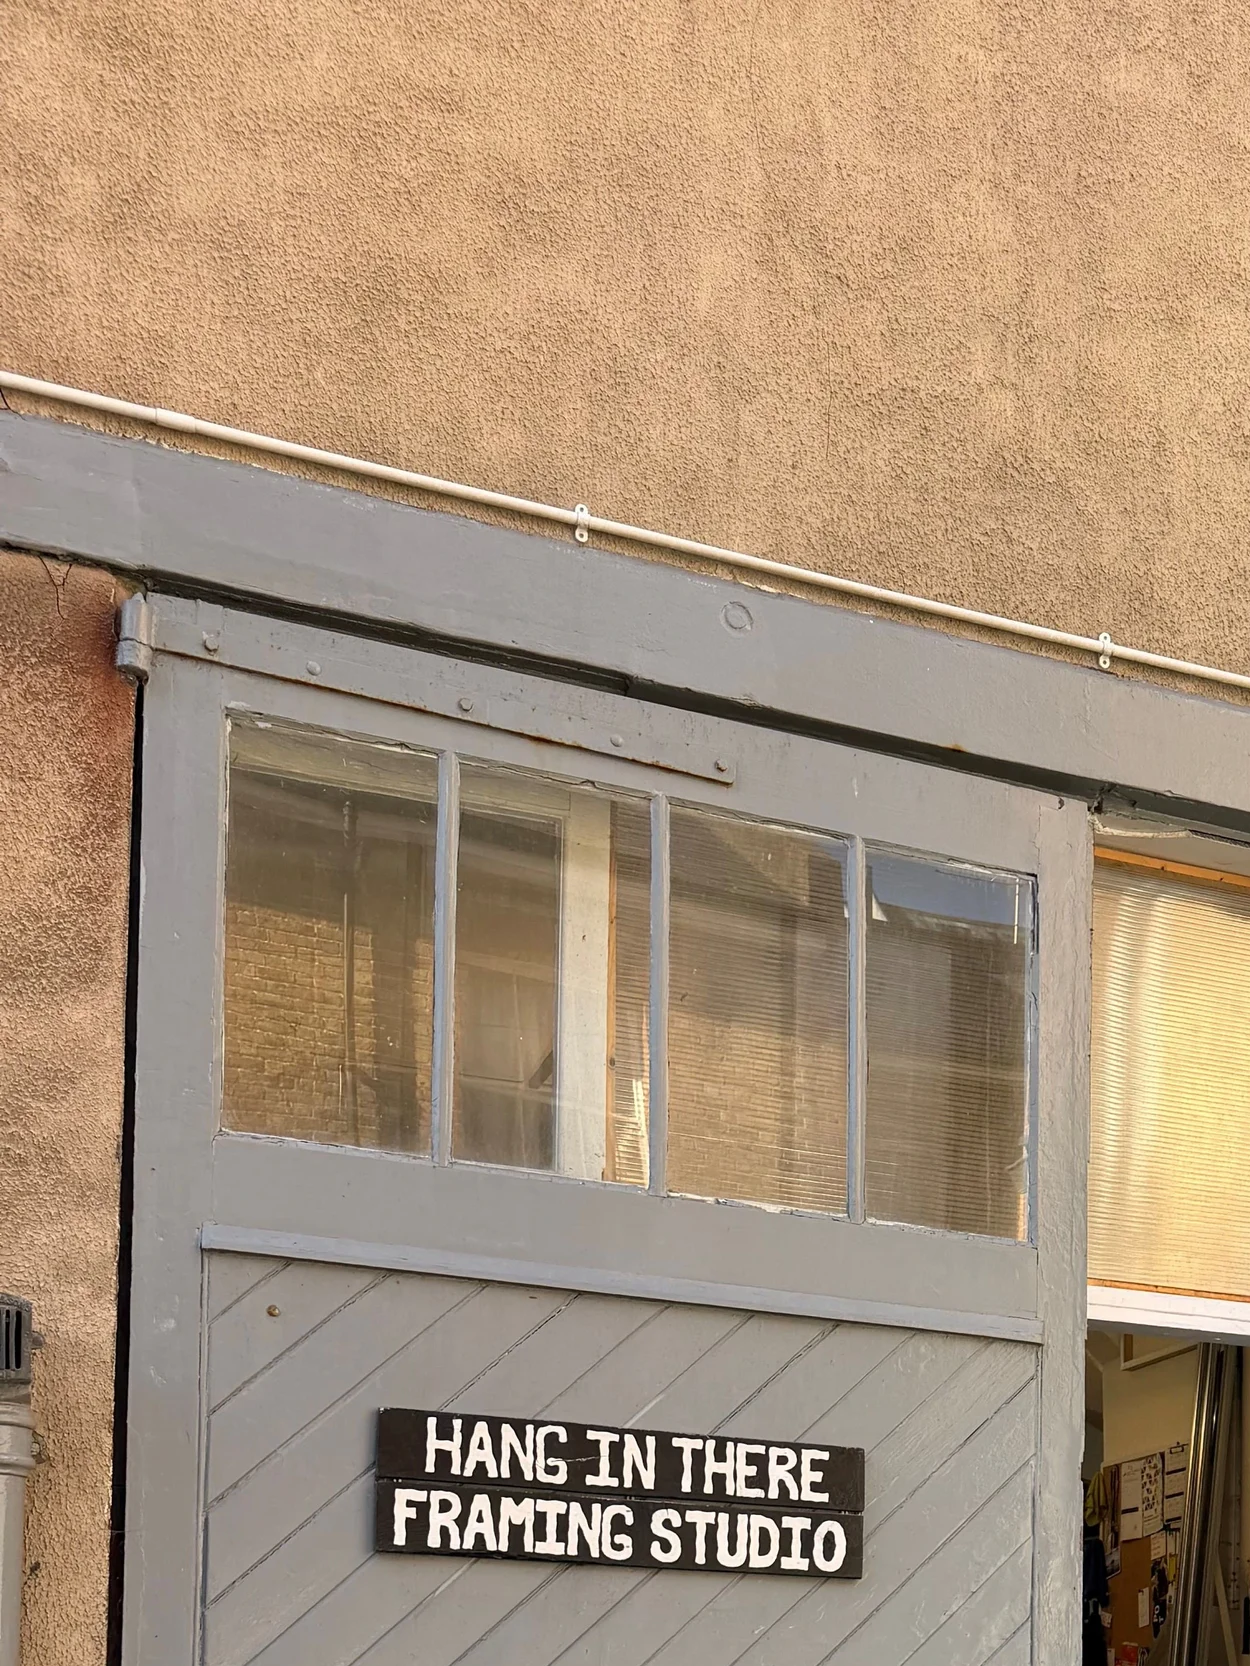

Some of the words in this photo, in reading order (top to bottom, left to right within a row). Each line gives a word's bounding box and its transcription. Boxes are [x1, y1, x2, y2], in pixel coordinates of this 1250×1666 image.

[425, 1416, 568, 1485] HANG
[585, 1428, 656, 1493] IN
[671, 1436, 830, 1503] THERE
[393, 1488, 634, 1561] FRAMING
[651, 1509, 847, 1573] STUDIO
